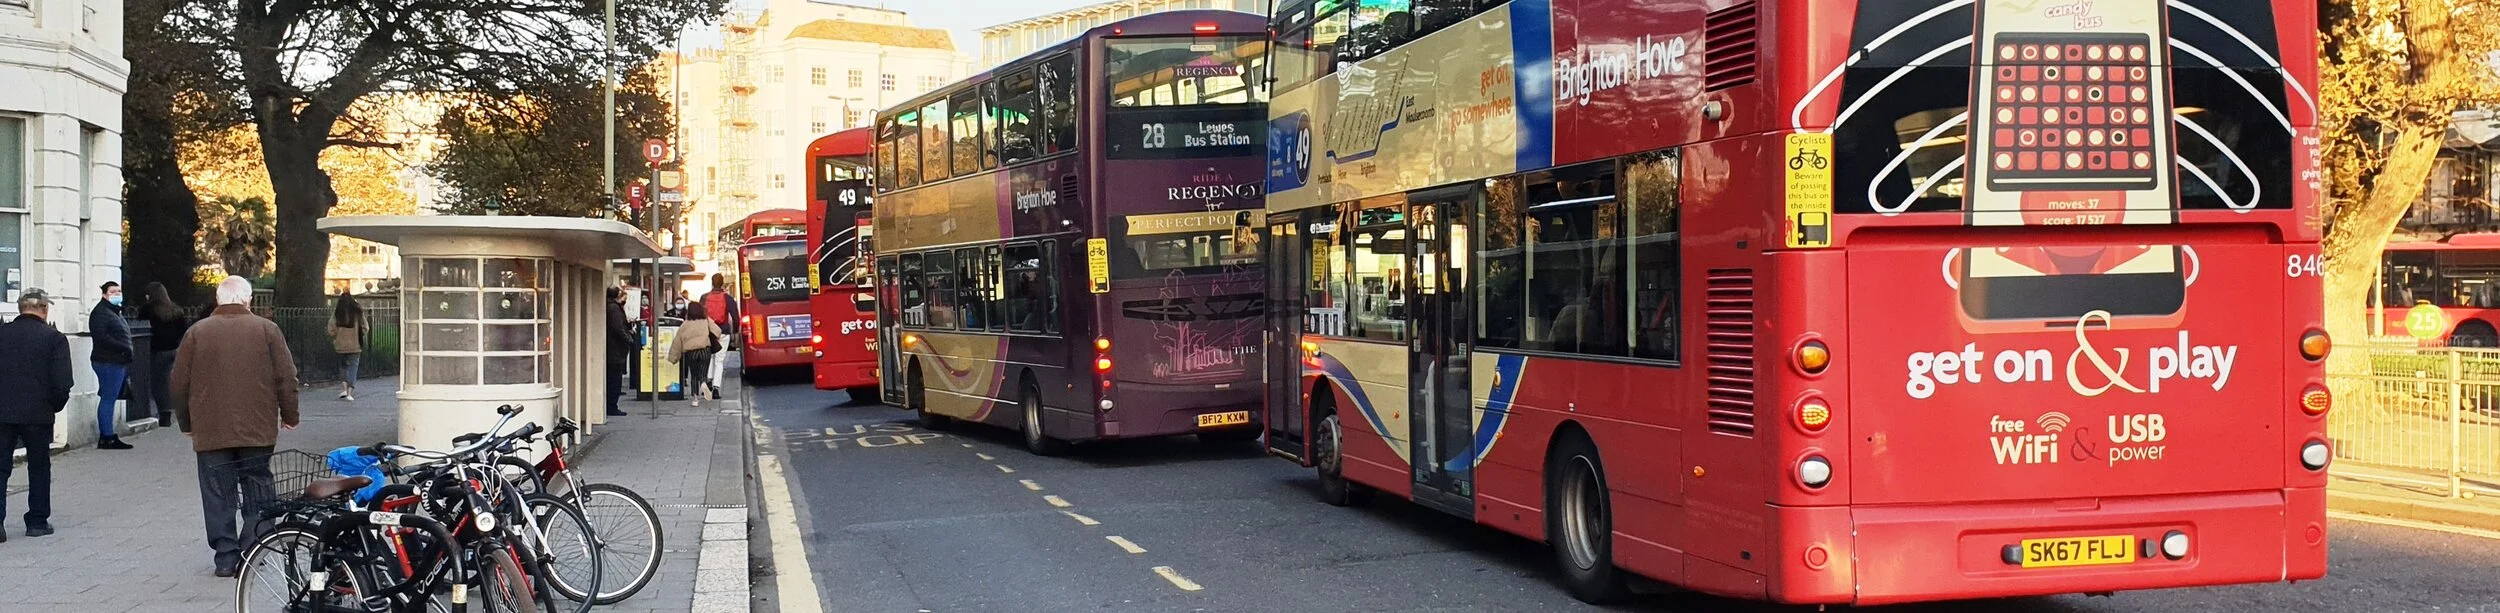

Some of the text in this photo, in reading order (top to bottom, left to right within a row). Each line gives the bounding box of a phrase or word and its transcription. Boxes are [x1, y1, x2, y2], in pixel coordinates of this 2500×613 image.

[2044, 0, 2093, 19] candy
[2074, 13, 2103, 30] bus
[1176, 66, 1235, 77] REGENCY
[1560, 49, 1628, 106] Brighton
[1636, 33, 1685, 80] Hove
[1481, 66, 1495, 97] get
[1451, 92, 1512, 136] go somewhere
[1142, 122, 1166, 149] 28
[1199, 121, 1235, 134] Lewes
[1184, 132, 1250, 147] Bus Station
[1790, 136, 1827, 146] Cyclists
[650, 144, 662, 158] D
[1296, 127, 1311, 170] 49
[1192, 173, 1233, 183] RIDE A
[1794, 172, 1824, 180] Beware
[631, 186, 641, 197] E
[1168, 183, 1256, 200] REGENC
[1790, 182, 1828, 191] of passing
[838, 188, 856, 206] 49
[1016, 186, 1057, 214] Brighton Hove
[1205, 196, 1225, 214] for
[2048, 198, 2100, 210] moves: 37
[1136, 213, 1265, 230] PERFECT POTER
[2043, 216, 2074, 225] score:
[766, 276, 786, 291] 25X
[841, 319, 862, 335] get
[2411, 312, 2438, 331] 25
[1232, 345, 1257, 355] THE
[1905, 310, 2238, 399] get on & play
[1202, 411, 1245, 425] BF12 KXM
[1990, 415, 2025, 433] free
[782, 423, 914, 442] BUS
[2108, 414, 2166, 443] USB
[1990, 427, 2102, 465] WiFi &
[2109, 443, 2166, 467] power
[2030, 537, 2126, 563] SK67 FLJ
